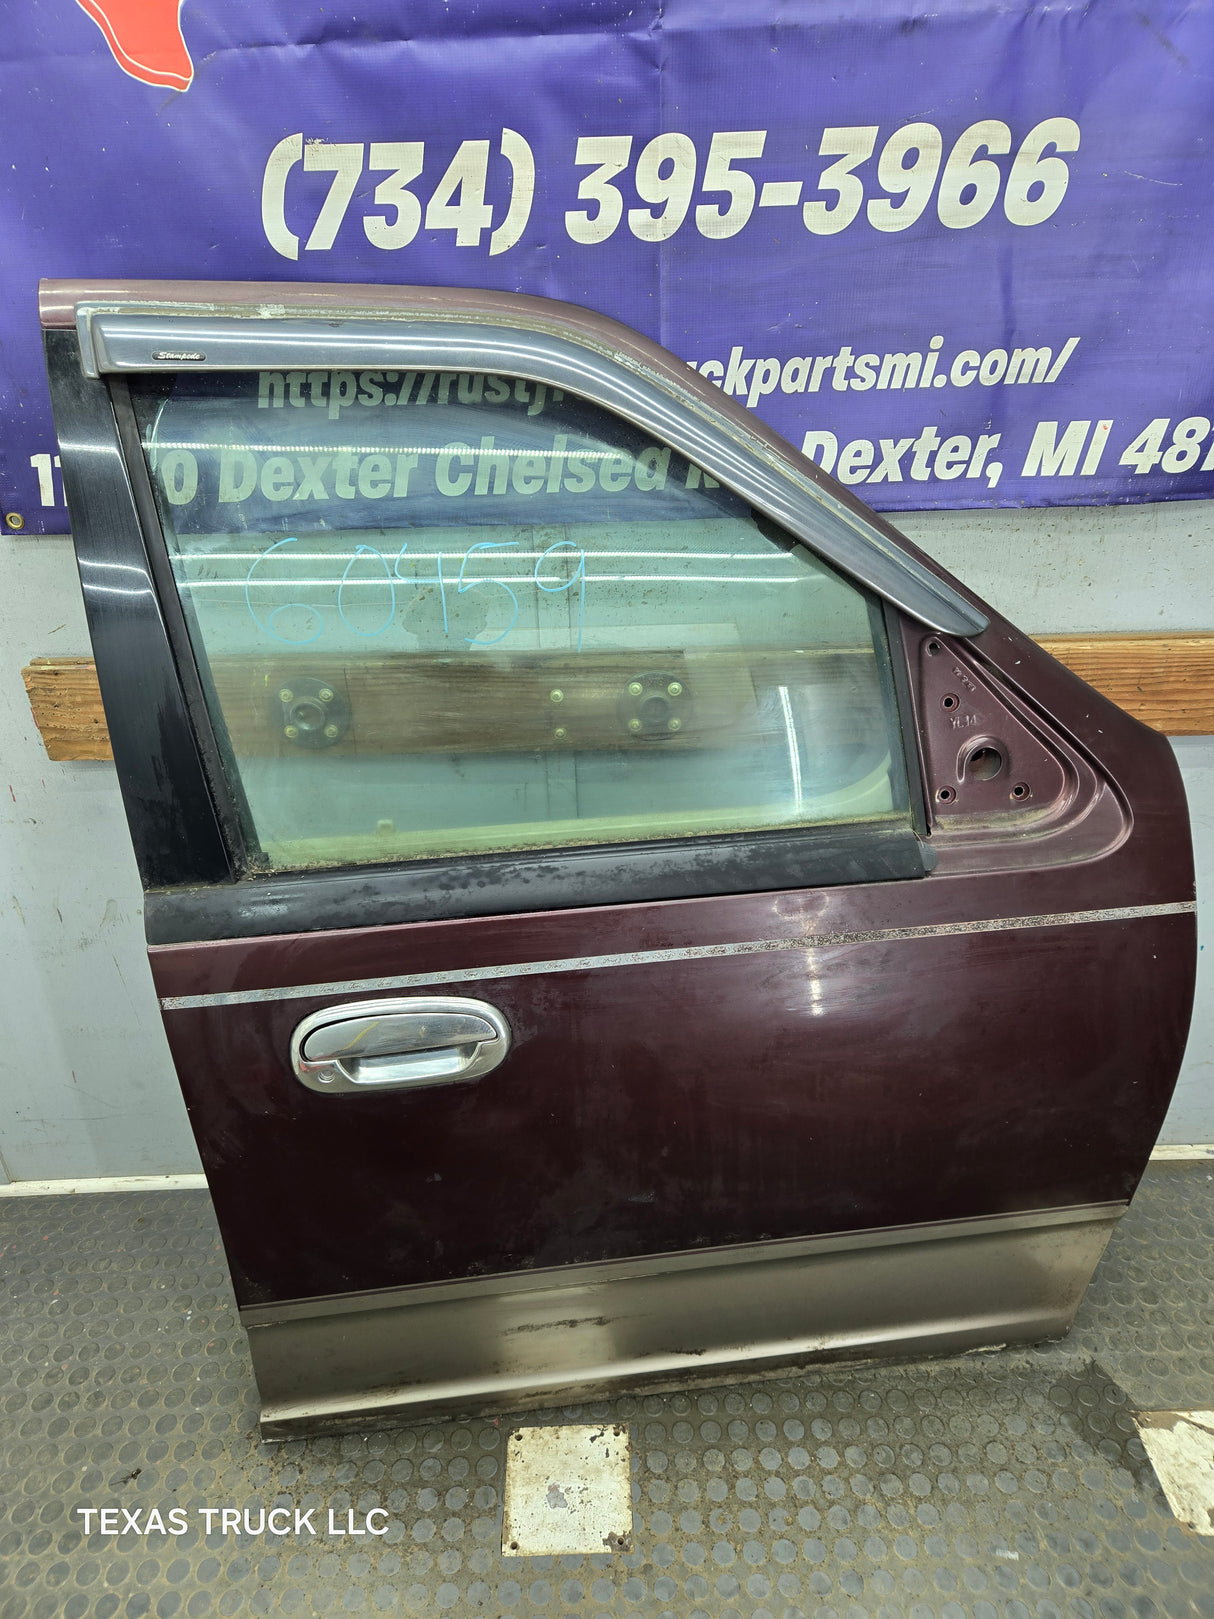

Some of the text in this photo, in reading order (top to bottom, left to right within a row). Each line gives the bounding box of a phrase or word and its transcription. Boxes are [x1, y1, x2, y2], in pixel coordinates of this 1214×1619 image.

[261, 117, 1081, 261] (734) 395-3966
[157, 351, 200, 361] Stampede
[217, 439, 421, 503] Dexter
[435, 434, 671, 497] Chelsea
[801, 426, 1002, 489] Dexter,
[1021, 420, 1114, 477] MI
[246, 538, 585, 653] 60459
